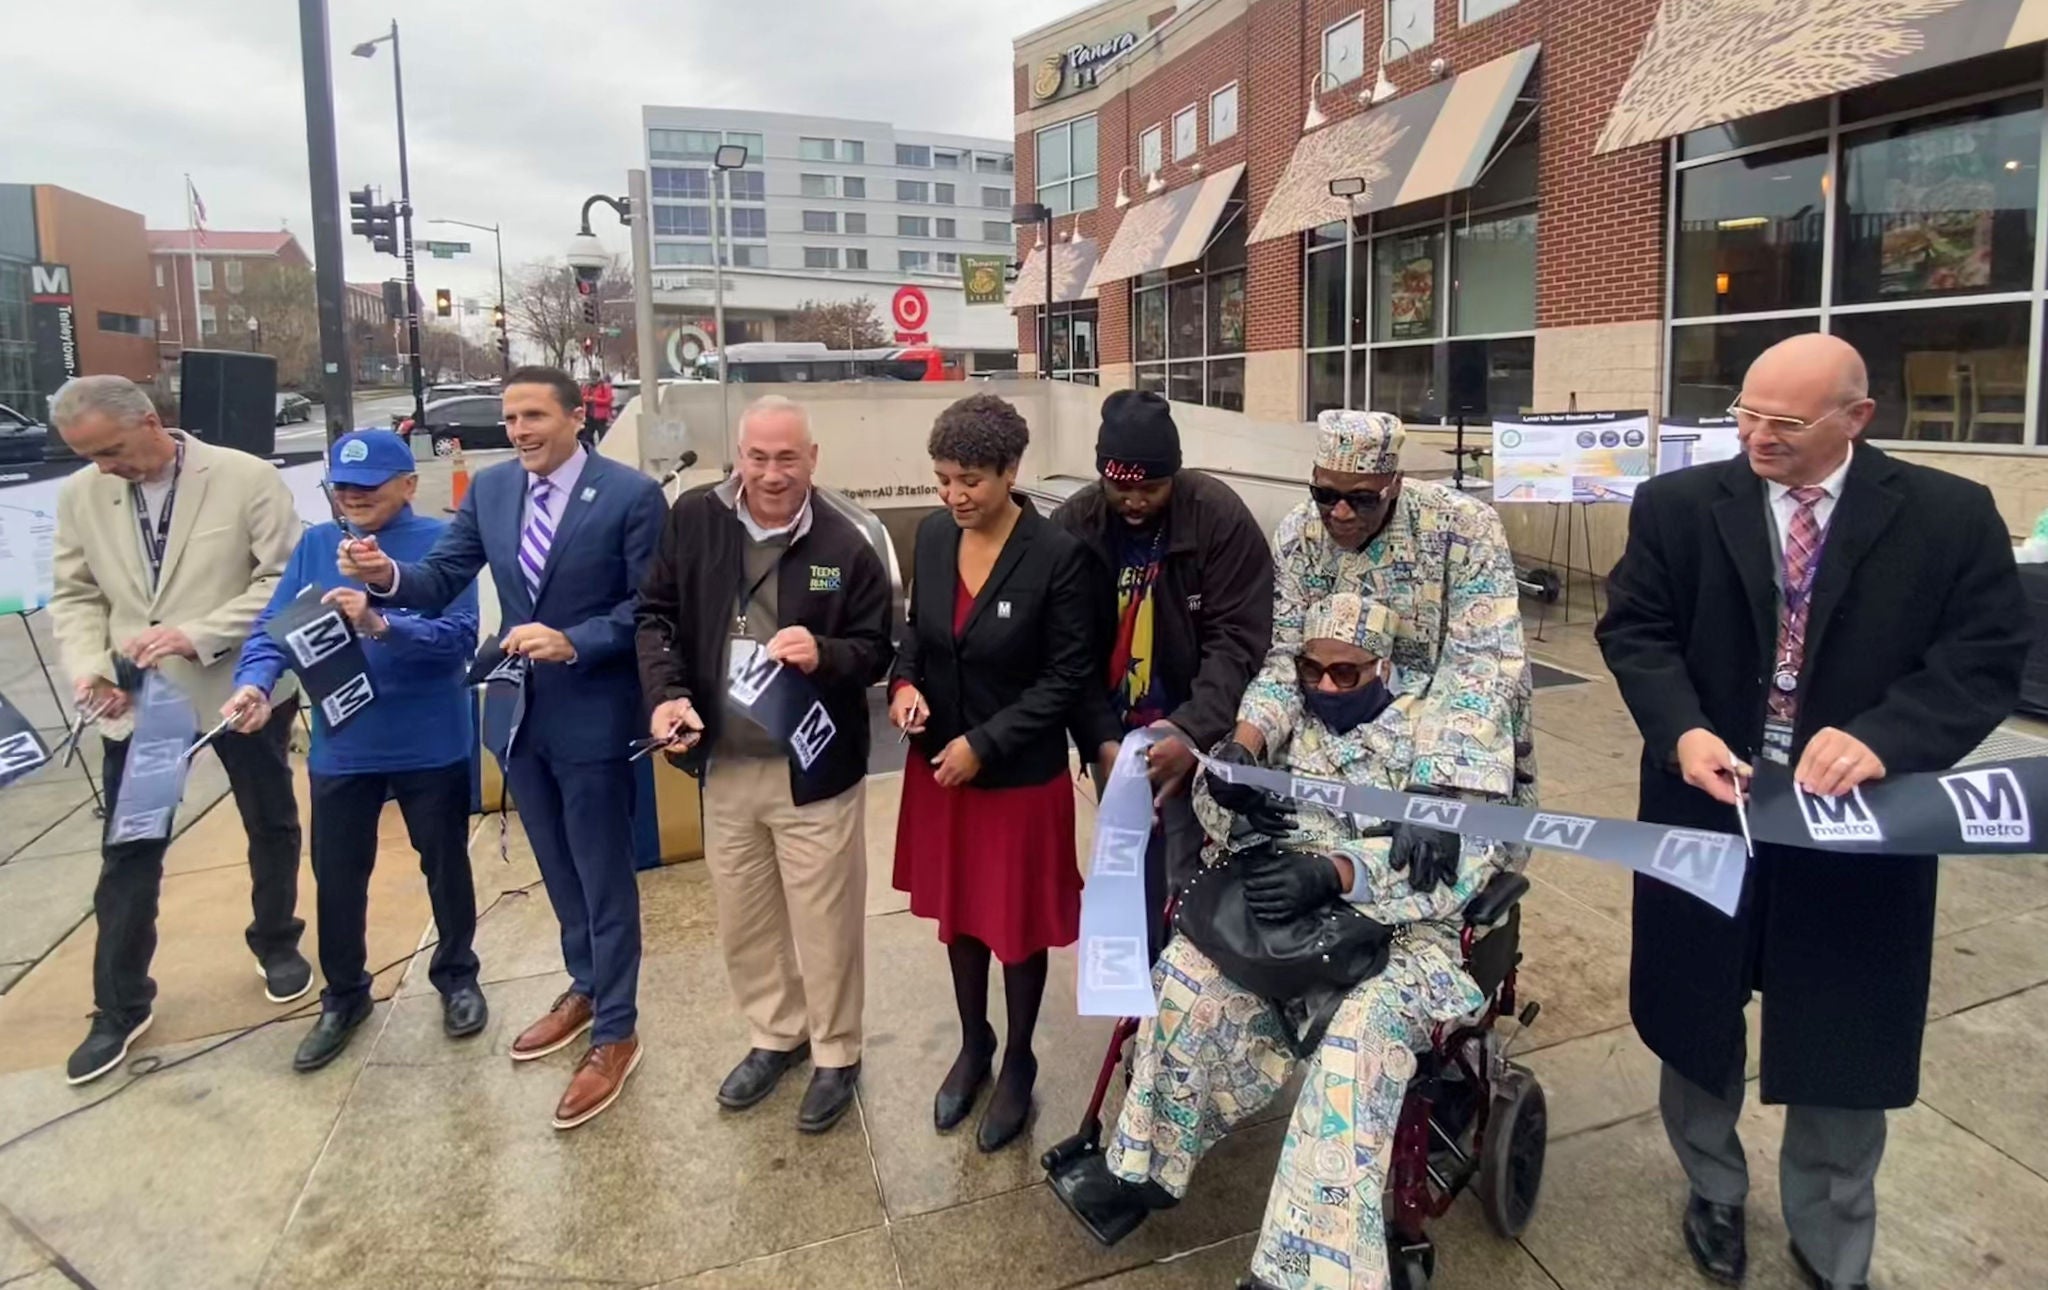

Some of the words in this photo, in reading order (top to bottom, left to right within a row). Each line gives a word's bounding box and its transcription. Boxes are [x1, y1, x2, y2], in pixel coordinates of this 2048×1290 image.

[1066, 32, 1135, 68] Panera
[32, 266, 70, 293] M
[897, 484, 938, 496] Station
[303, 615, 347, 657] M
[335, 677, 371, 716] M
[799, 706, 833, 756] M
[1801, 782, 1868, 824] M
[1946, 772, 2022, 820] M
[1813, 823, 1875, 837] metro
[1966, 822, 2025, 837] metro
